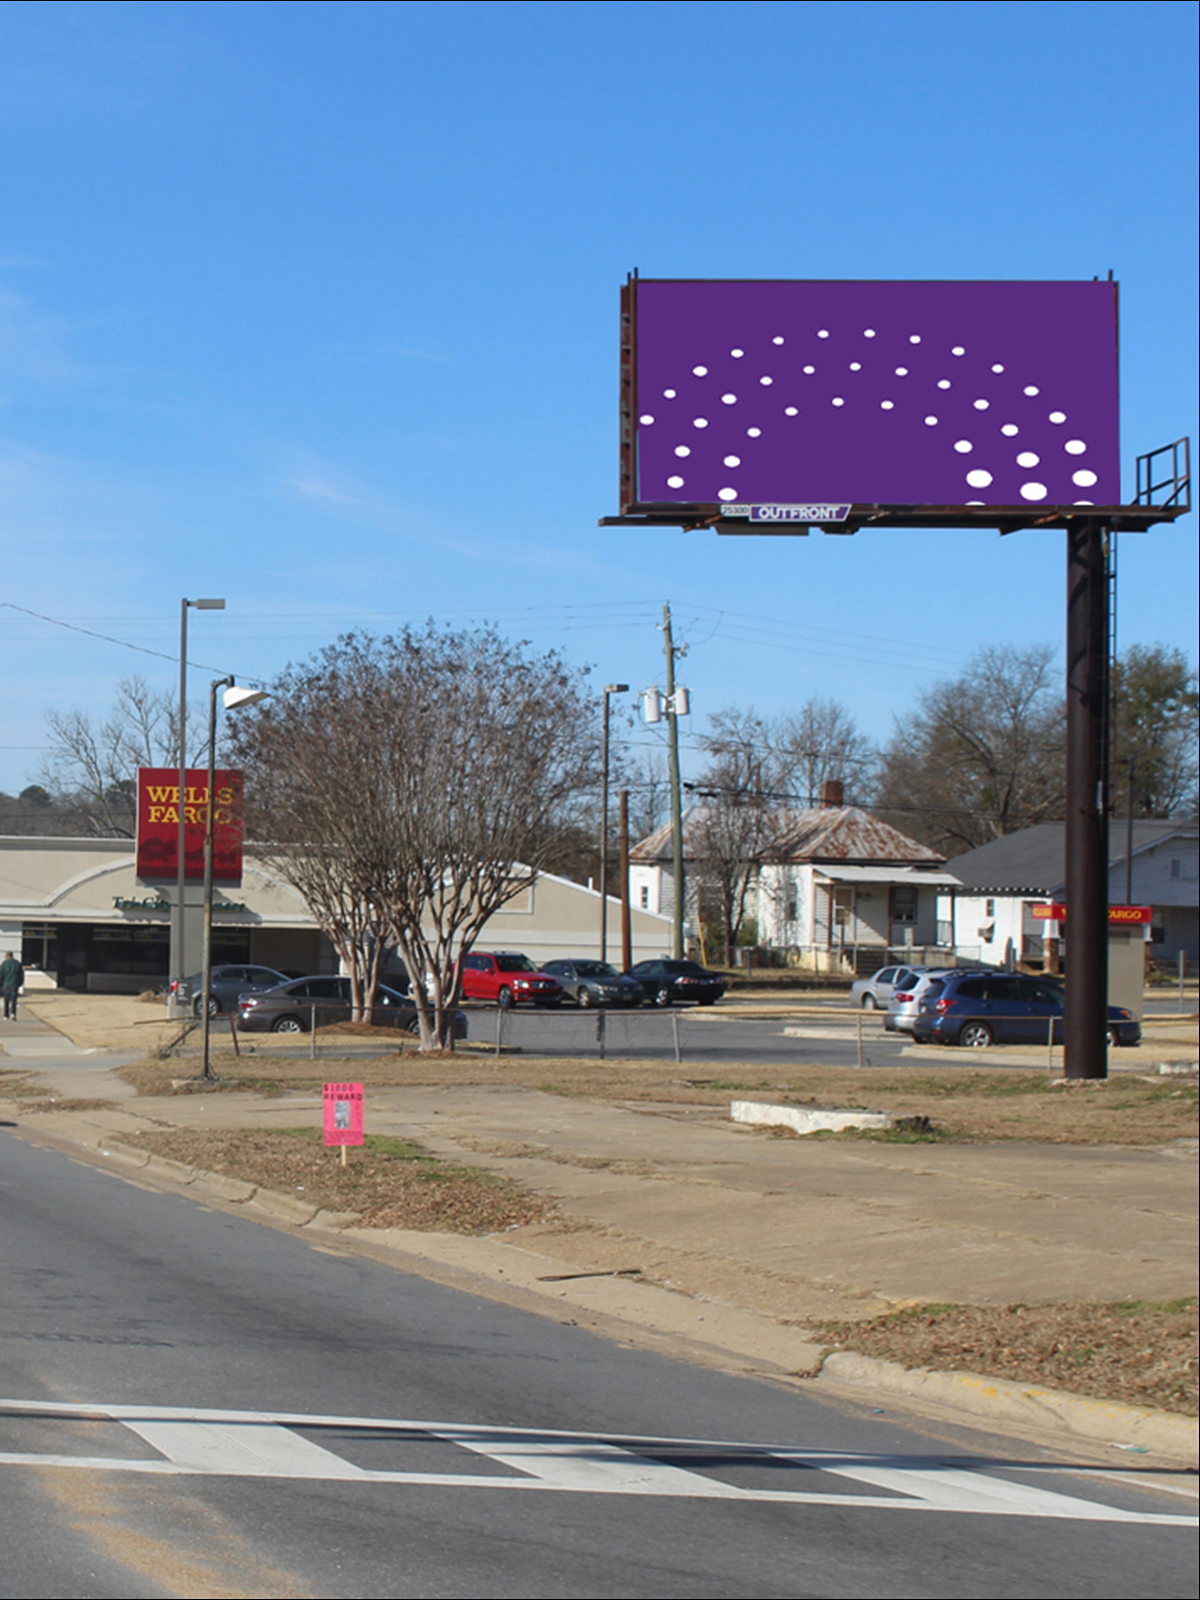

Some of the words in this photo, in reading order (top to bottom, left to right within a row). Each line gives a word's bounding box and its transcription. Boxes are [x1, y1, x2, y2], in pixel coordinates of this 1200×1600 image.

[759, 506, 840, 519] OUTFRONT
[145, 786, 234, 804] WELLS
[1108, 910, 1142, 919] ARGO
